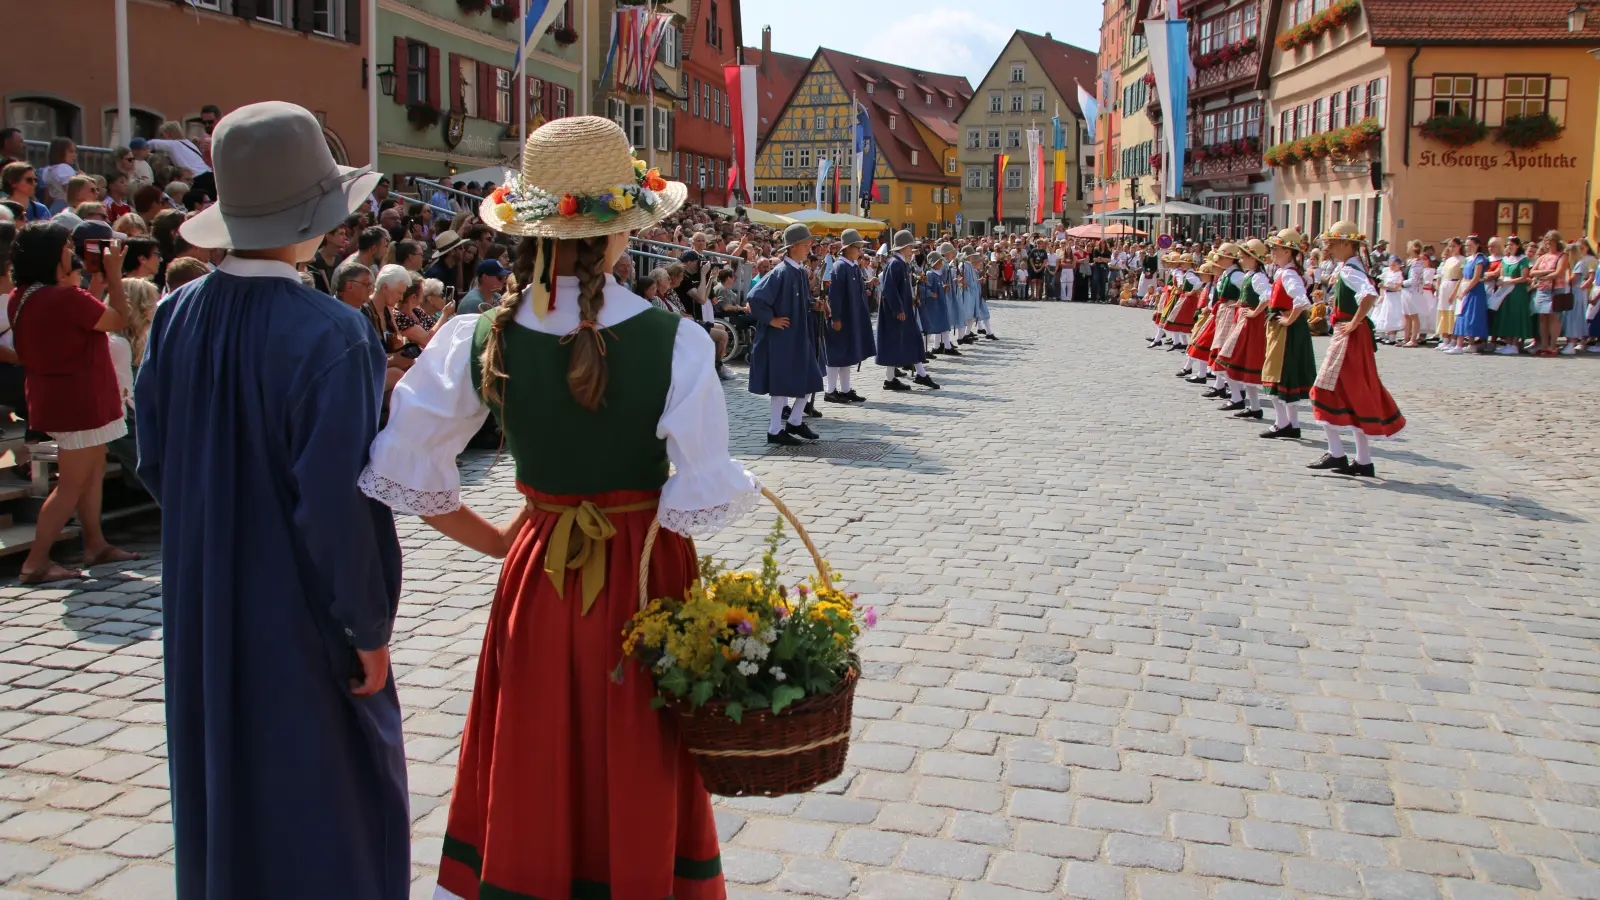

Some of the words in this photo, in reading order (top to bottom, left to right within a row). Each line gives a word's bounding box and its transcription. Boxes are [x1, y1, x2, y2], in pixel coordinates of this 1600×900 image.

[1502, 150, 1578, 171] Apotheke
[1499, 206, 1510, 219] A
[1518, 207, 1530, 220] A
